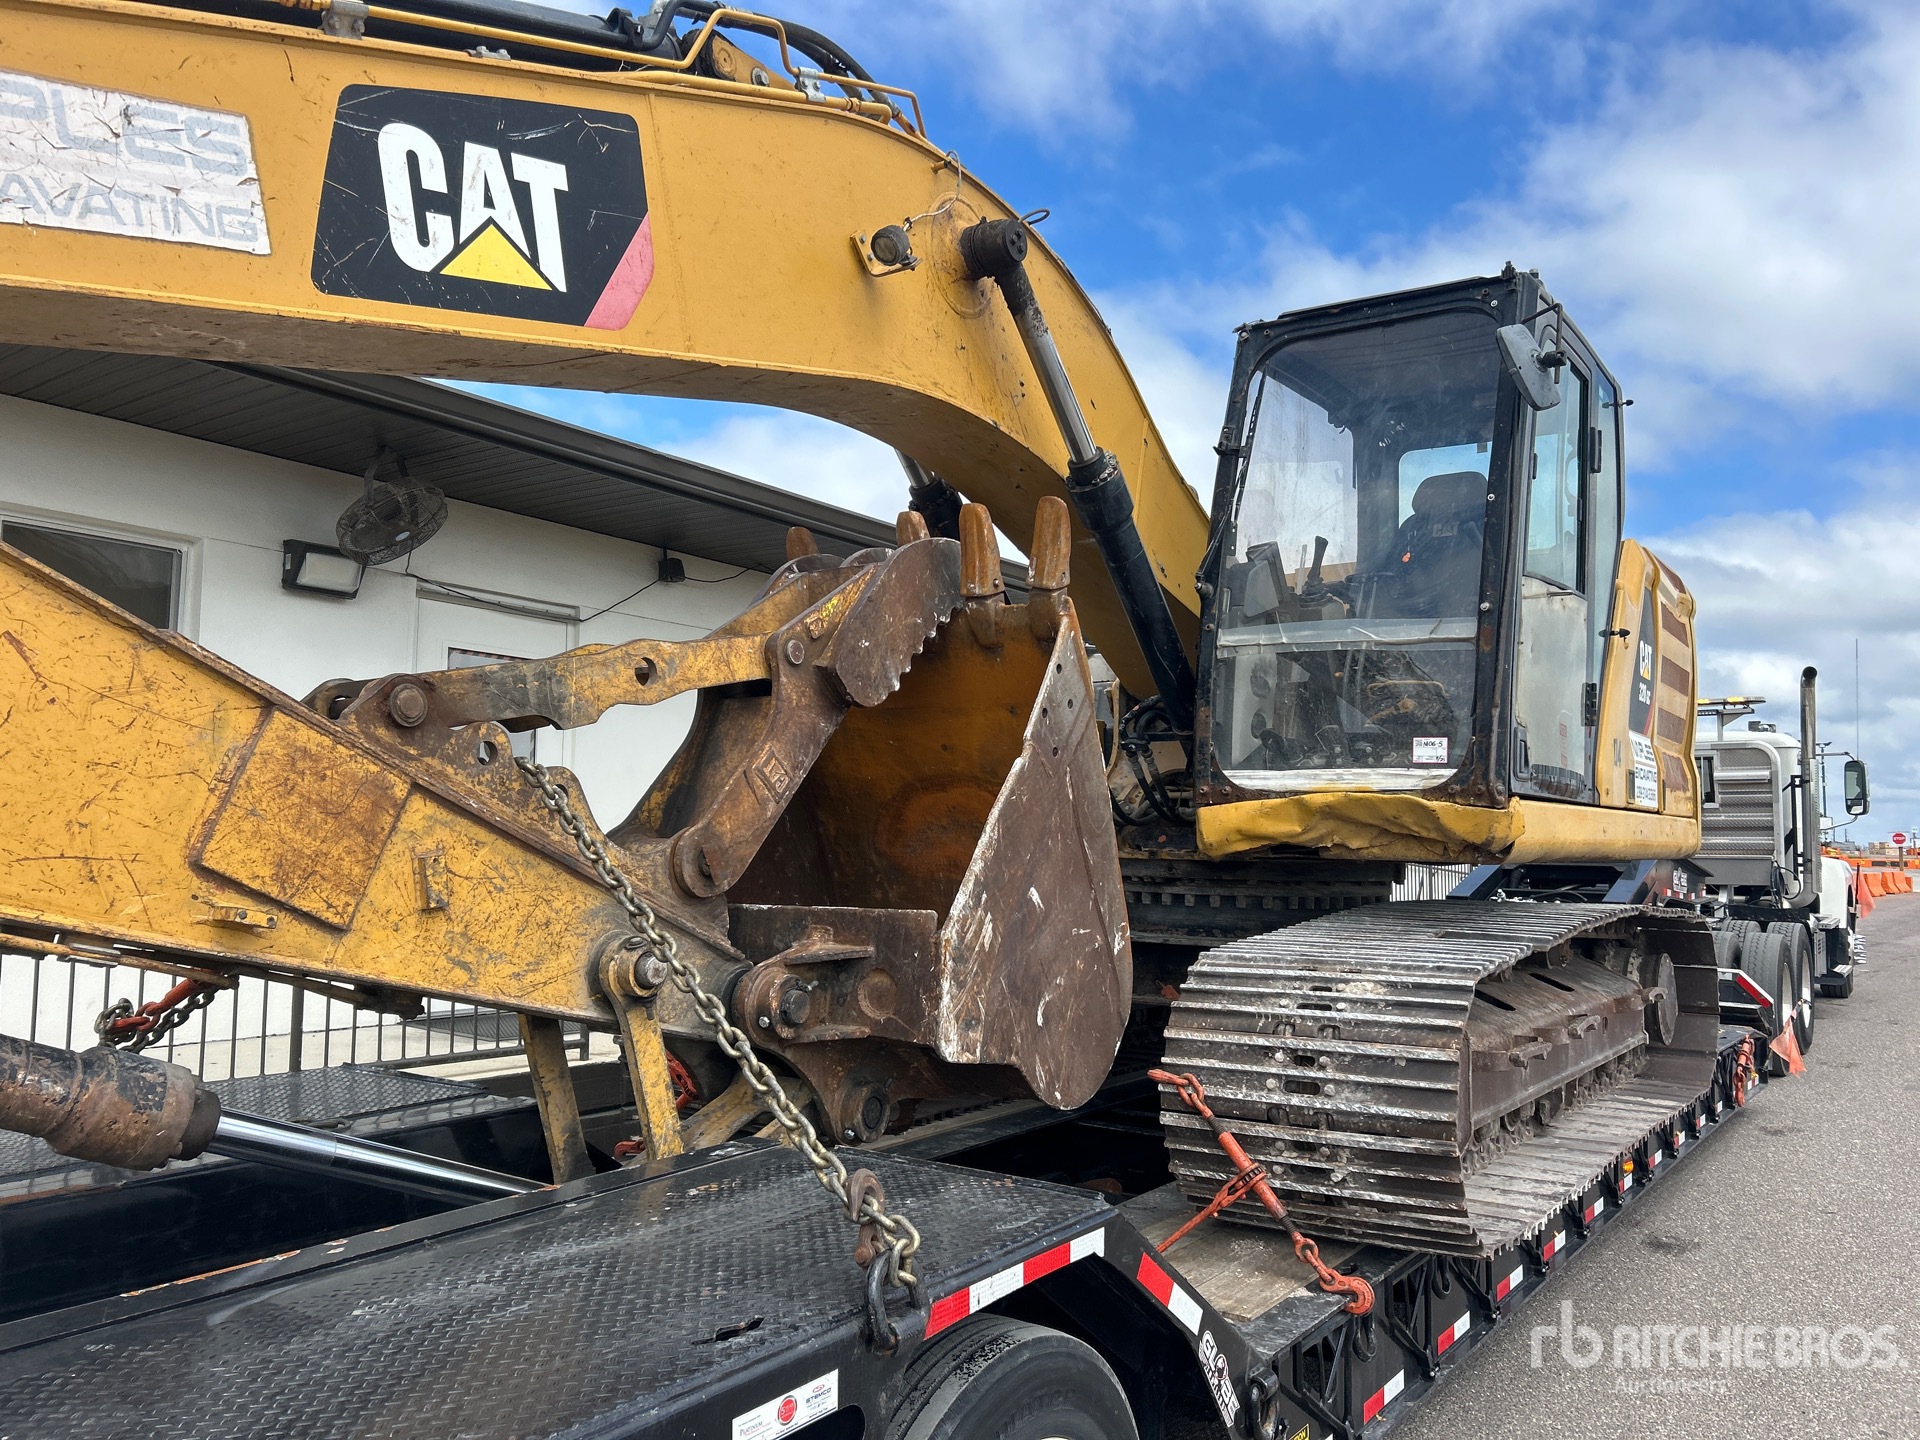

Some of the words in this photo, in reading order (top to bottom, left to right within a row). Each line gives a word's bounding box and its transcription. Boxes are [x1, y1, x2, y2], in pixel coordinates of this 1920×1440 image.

[377, 122, 569, 293] CAT
[1640, 640, 1652, 681] CAT
[806, 1387, 832, 1404] STEMCO
